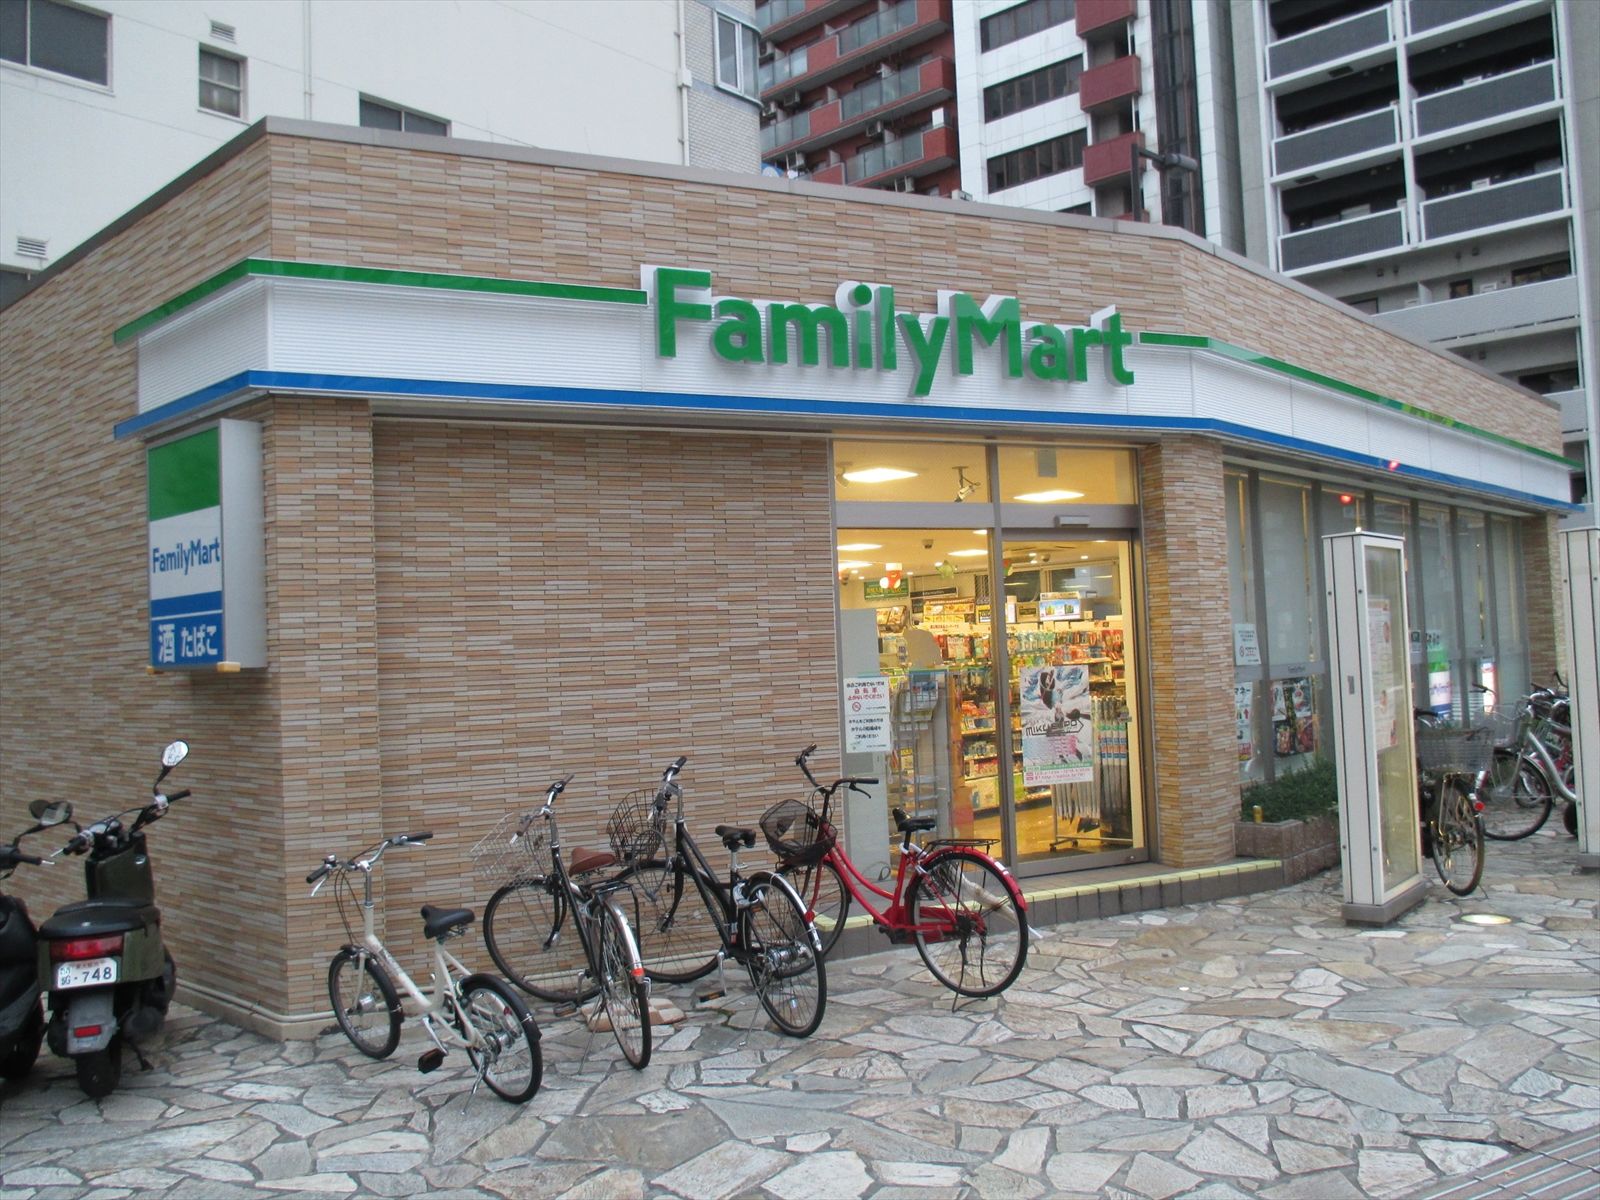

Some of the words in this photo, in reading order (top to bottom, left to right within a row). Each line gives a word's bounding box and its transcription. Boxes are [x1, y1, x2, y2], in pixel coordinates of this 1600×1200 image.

[648, 265, 1135, 397] FamilyMart
[152, 537, 220, 575] FamilyMart
[158, 624, 176, 663] 酒
[181, 625, 218, 657] たばこ
[82, 967, 112, 983] 748
